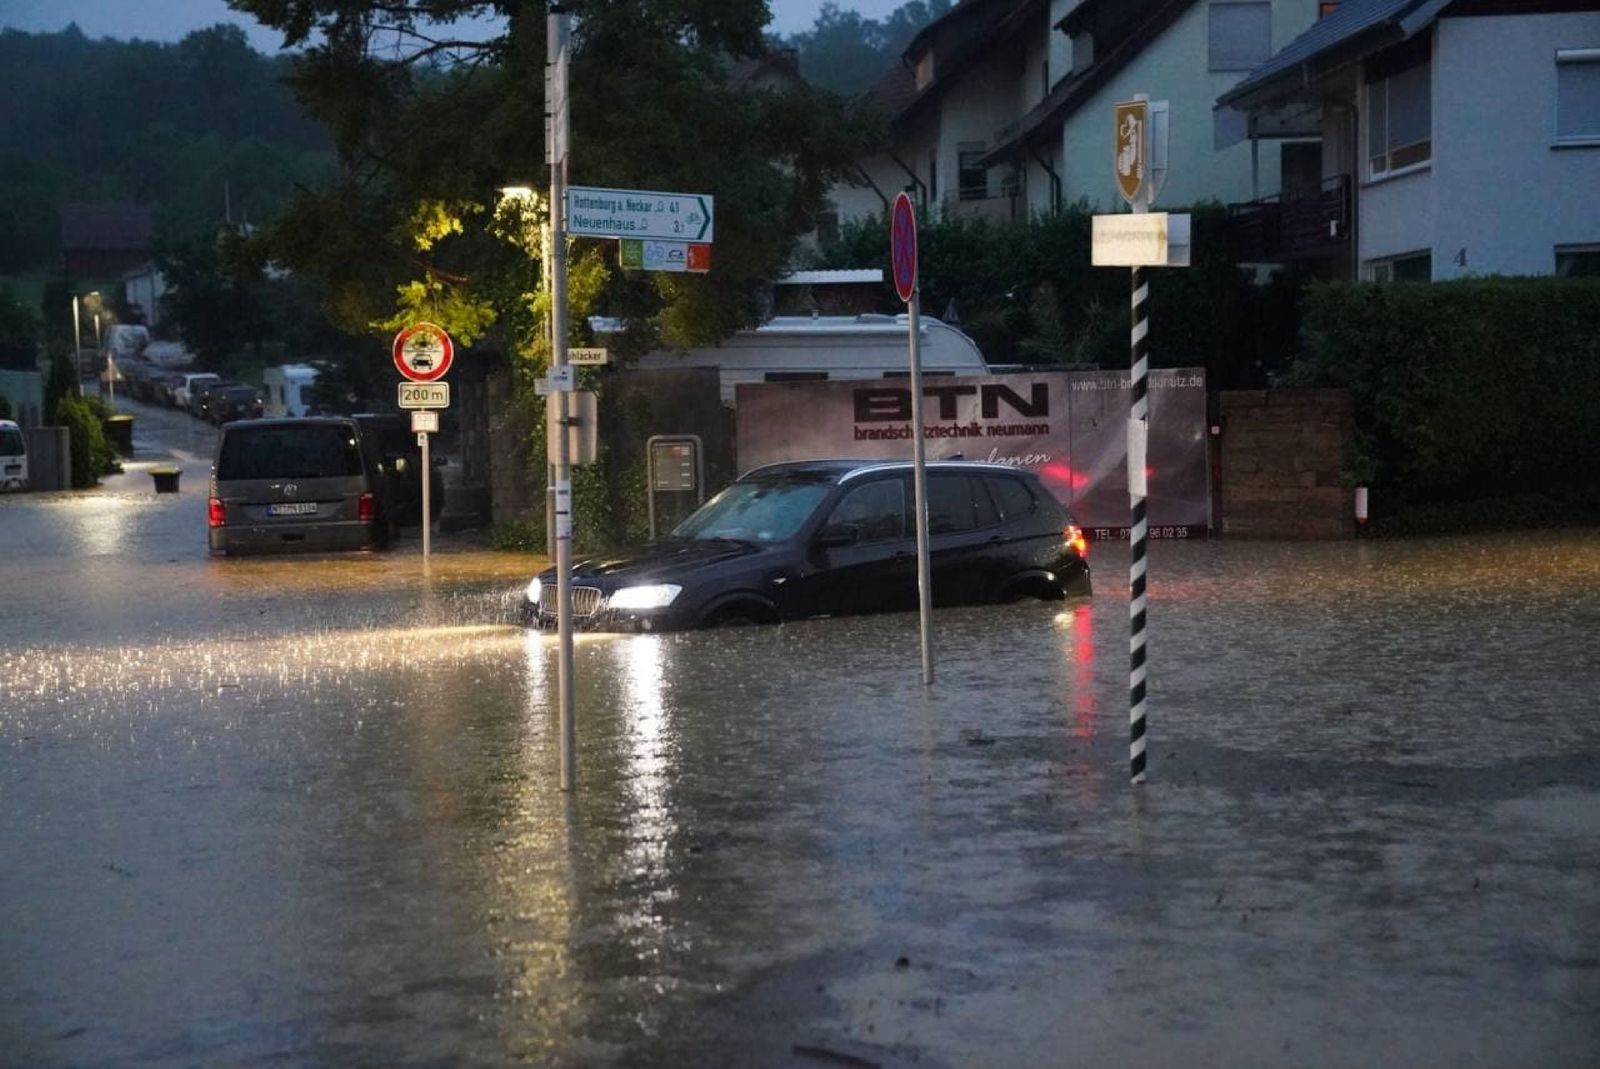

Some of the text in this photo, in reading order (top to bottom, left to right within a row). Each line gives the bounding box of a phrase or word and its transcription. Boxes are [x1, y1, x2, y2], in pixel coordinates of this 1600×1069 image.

[626, 199, 653, 213] Neckar
[573, 214, 636, 231] Neuenhaus
[1453, 248, 1467, 267] 4
[405, 389, 443, 401] 200 m
[853, 383, 1049, 422] BTN
[854, 422, 1050, 440] brandschtztechnik neumann
[1163, 528, 1174, 538] 02
[1176, 527, 1188, 538] 35
